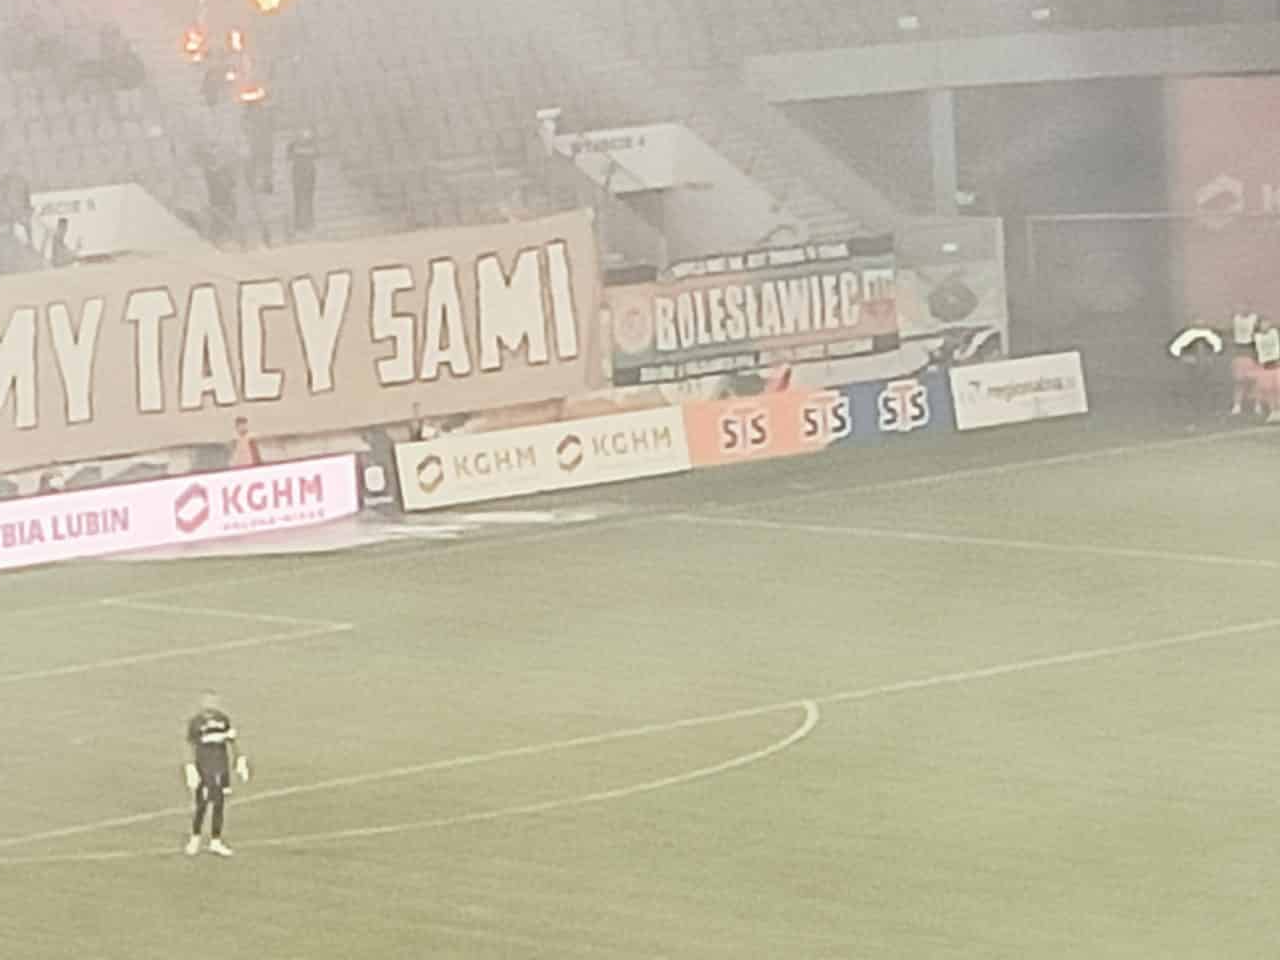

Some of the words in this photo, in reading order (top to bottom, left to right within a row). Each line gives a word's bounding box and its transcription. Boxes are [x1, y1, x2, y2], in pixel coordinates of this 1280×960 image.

[126, 269, 352, 414] TACY
[370, 237, 579, 387] SAMI
[882, 384, 927, 426] STS
[592, 425, 673, 457] KGHM
[452, 445, 537, 480] KGHM
[222, 473, 325, 516] KGHM
[51, 505, 130, 541] LUBIN
